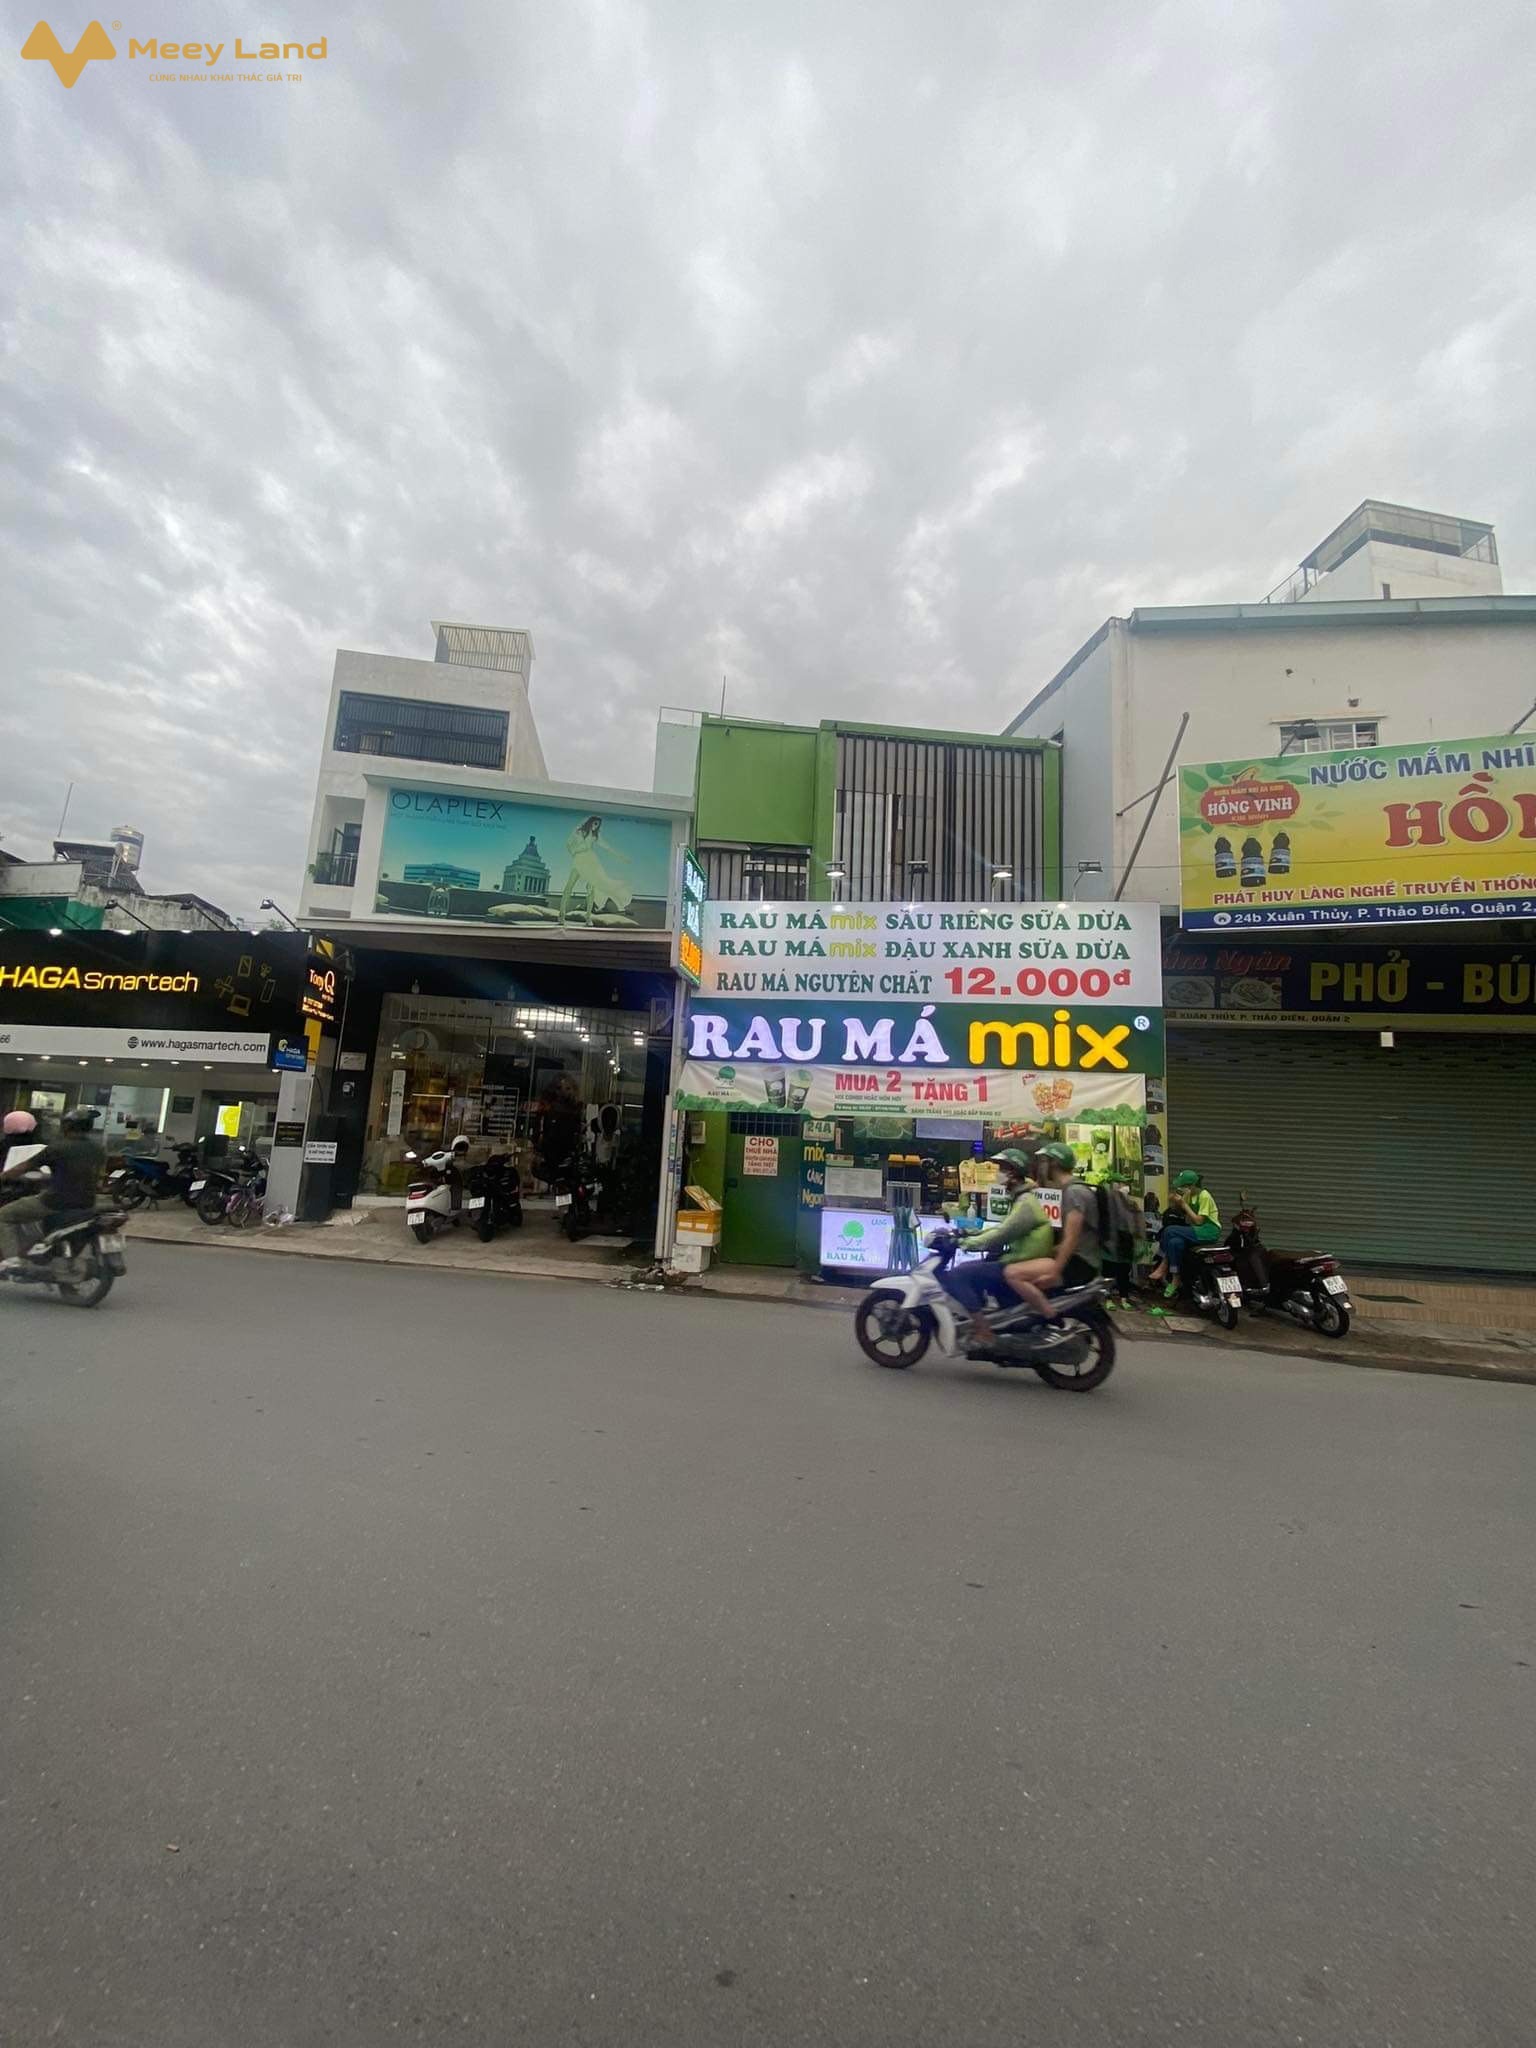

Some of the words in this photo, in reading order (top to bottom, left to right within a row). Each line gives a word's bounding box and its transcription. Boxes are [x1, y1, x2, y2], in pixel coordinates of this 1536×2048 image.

[1310, 756, 1388, 785] NƯỚC
[1398, 745, 1471, 777] MẮM
[392, 791, 503, 822] OLAPLEX
[1253, 797, 1293, 812] VINH
[1213, 891, 1256, 905] PHÁT
[1261, 890, 1295, 903] HUY
[1300, 886, 1345, 901] LÀNG
[1403, 877, 1476, 895] TRUYỀN
[1482, 874, 1536, 892] THỐN
[719, 912, 778, 930] RAU
[786, 909, 827, 930] MÁ
[830, 911, 878, 930] mix
[885, 908, 933, 930] SẦU
[939, 910, 1014, 931] RIÊNG
[1020, 908, 1071, 931] SỮA
[1078, 909, 1132, 931] DỪA
[1234, 913, 1262, 924] 24b
[1266, 911, 1305, 923] Xuân
[1358, 909, 1371, 919] P.
[1376, 905, 1417, 917] Thảo
[1470, 899, 1516, 916] Quận
[718, 939, 777, 957] RAU
[785, 936, 826, 957] MÁ
[829, 938, 877, 958] mix
[884, 938, 936, 961] ĐẬU
[942, 942, 1012, 959] XANH
[1018, 938, 1069, 960] SỮA
[1075, 938, 1131, 960] DỪA
[0, 965, 82, 989] HAGA
[716, 972, 757, 992] RAU
[761, 968, 789, 992] MÁ
[794, 970, 874, 993] NGUYÊN
[879, 969, 933, 994] CHẤT
[1309, 950, 1411, 1003] PHỞ
[1462, 954, 1536, 1005] BÚ
[140, 1038, 266, 1053] www.hagasmartech.com
[688, 1014, 827, 1062] RAU
[841, 1005, 951, 1063] MÁ
[968, 1008, 1131, 1070] mix
[835, 1073, 880, 1092] MUA
[886, 1070, 902, 1092] 2
[911, 1078, 968, 1106] TẶNG
[972, 1076, 988, 1102] 1
[808, 1120, 831, 1133] 24A
[749, 1137, 774, 1147] CHO
[803, 1142, 825, 1162] mix
